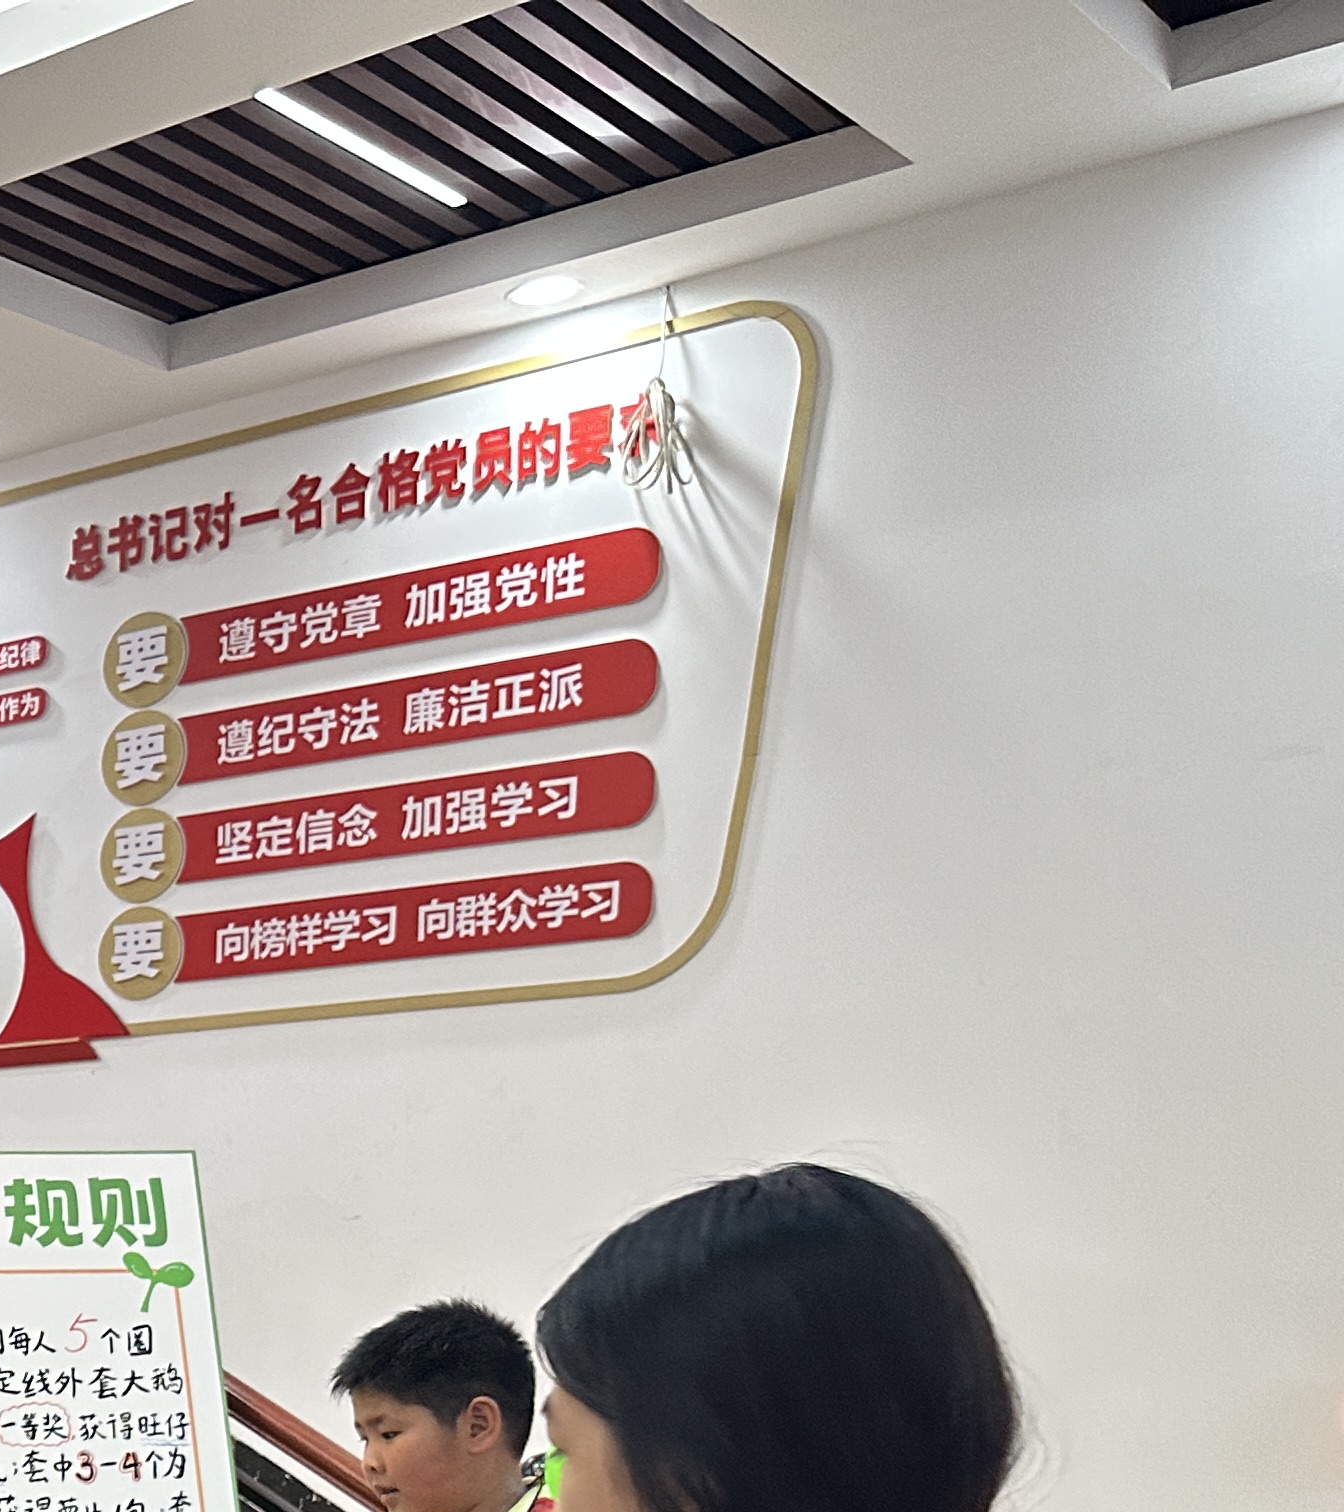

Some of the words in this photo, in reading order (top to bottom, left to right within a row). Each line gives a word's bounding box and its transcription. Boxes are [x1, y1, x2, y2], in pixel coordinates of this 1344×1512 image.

[116, 624, 169, 690] 要
[219, 594, 381, 664] 遵守党章
[405, 554, 586, 629] 加强党性
[115, 724, 168, 789] 要
[218, 699, 380, 766] 遵纪守法
[403, 663, 584, 735] 廉洁正派
[112, 823, 166, 886] 要
[215, 804, 377, 865] 坚定信念
[401, 776, 579, 840] 加强学习
[111, 922, 164, 982] 要
[215, 906, 397, 963] 向榜样学习
[417, 880, 620, 942] 向群众学习
